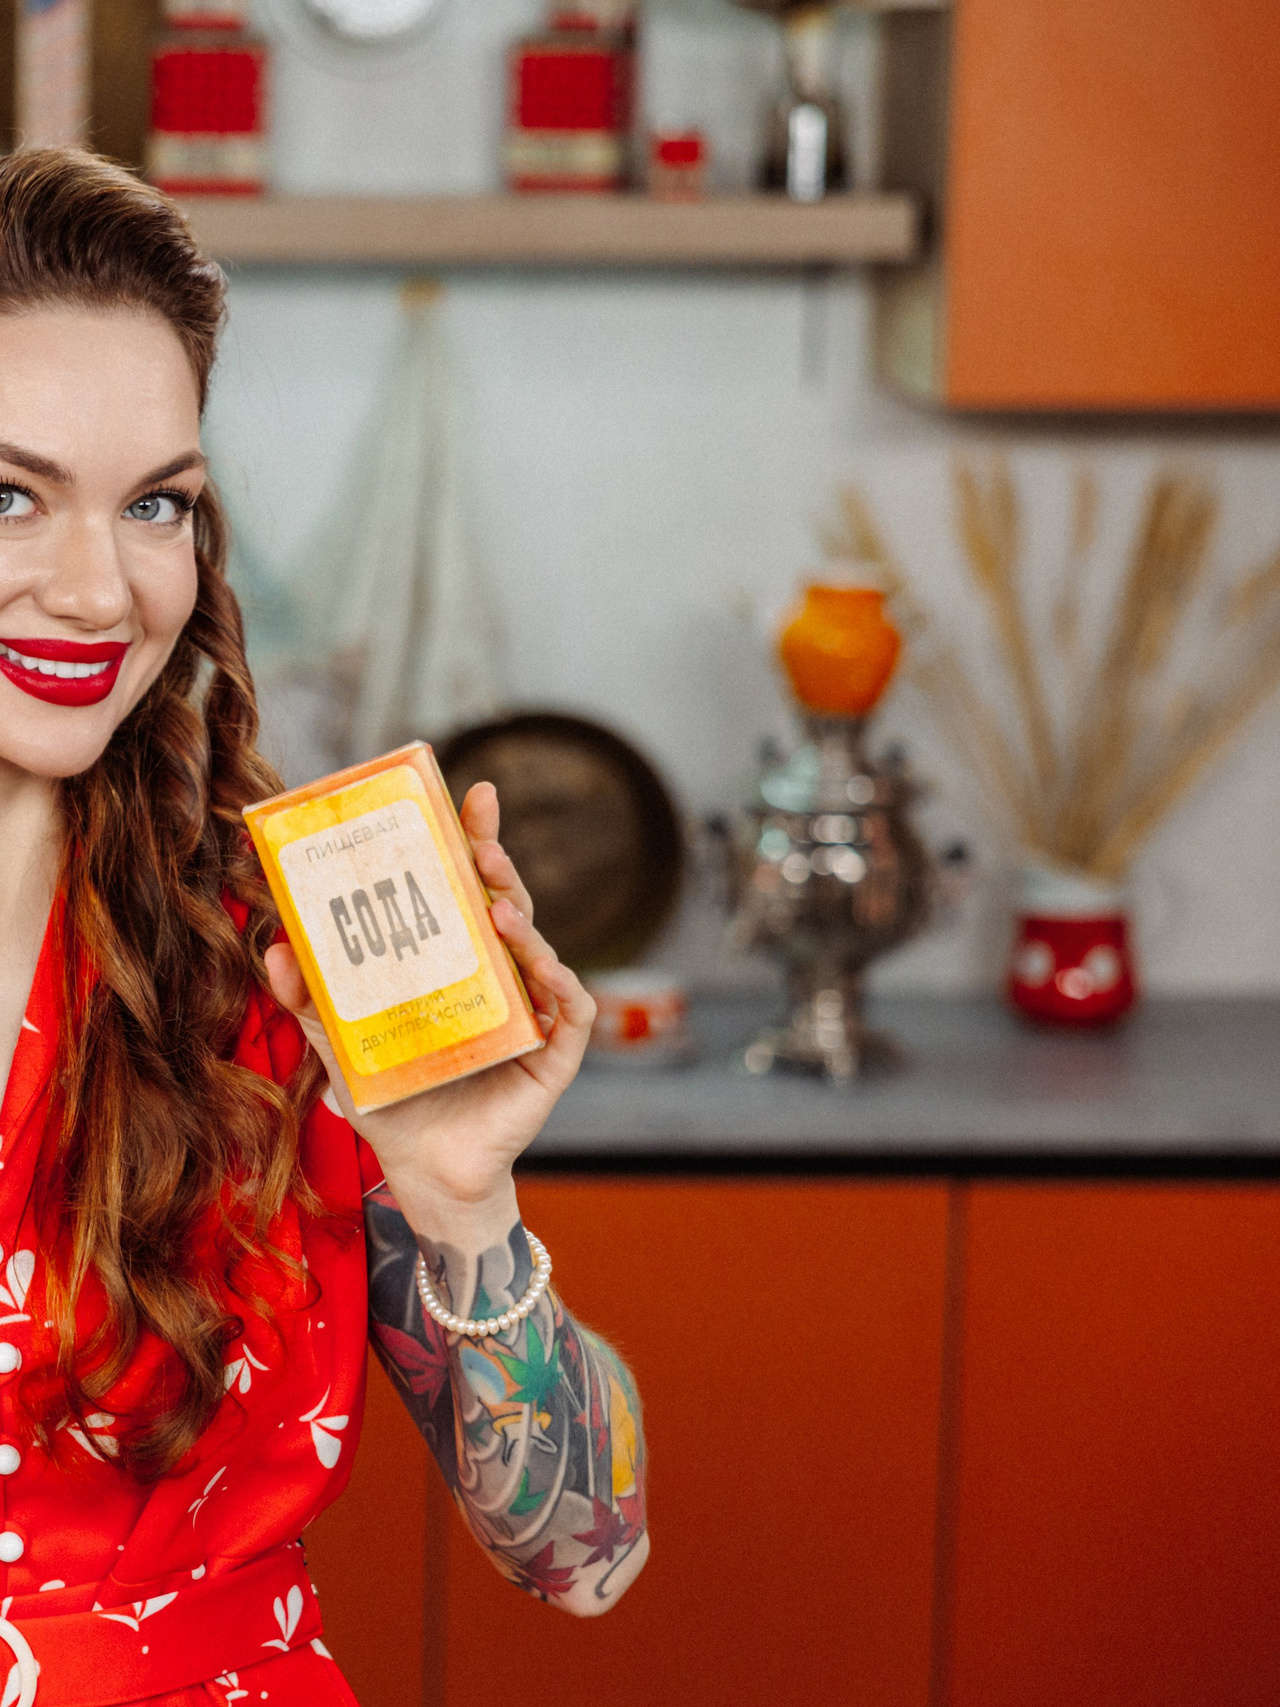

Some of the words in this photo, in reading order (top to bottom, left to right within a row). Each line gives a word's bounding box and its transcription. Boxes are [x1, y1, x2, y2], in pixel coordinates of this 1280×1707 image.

[305, 815, 400, 863] ПИЩЕВАЯ
[328, 870, 442, 967] СОДА
[385, 988, 446, 1021] НАТРИЙ
